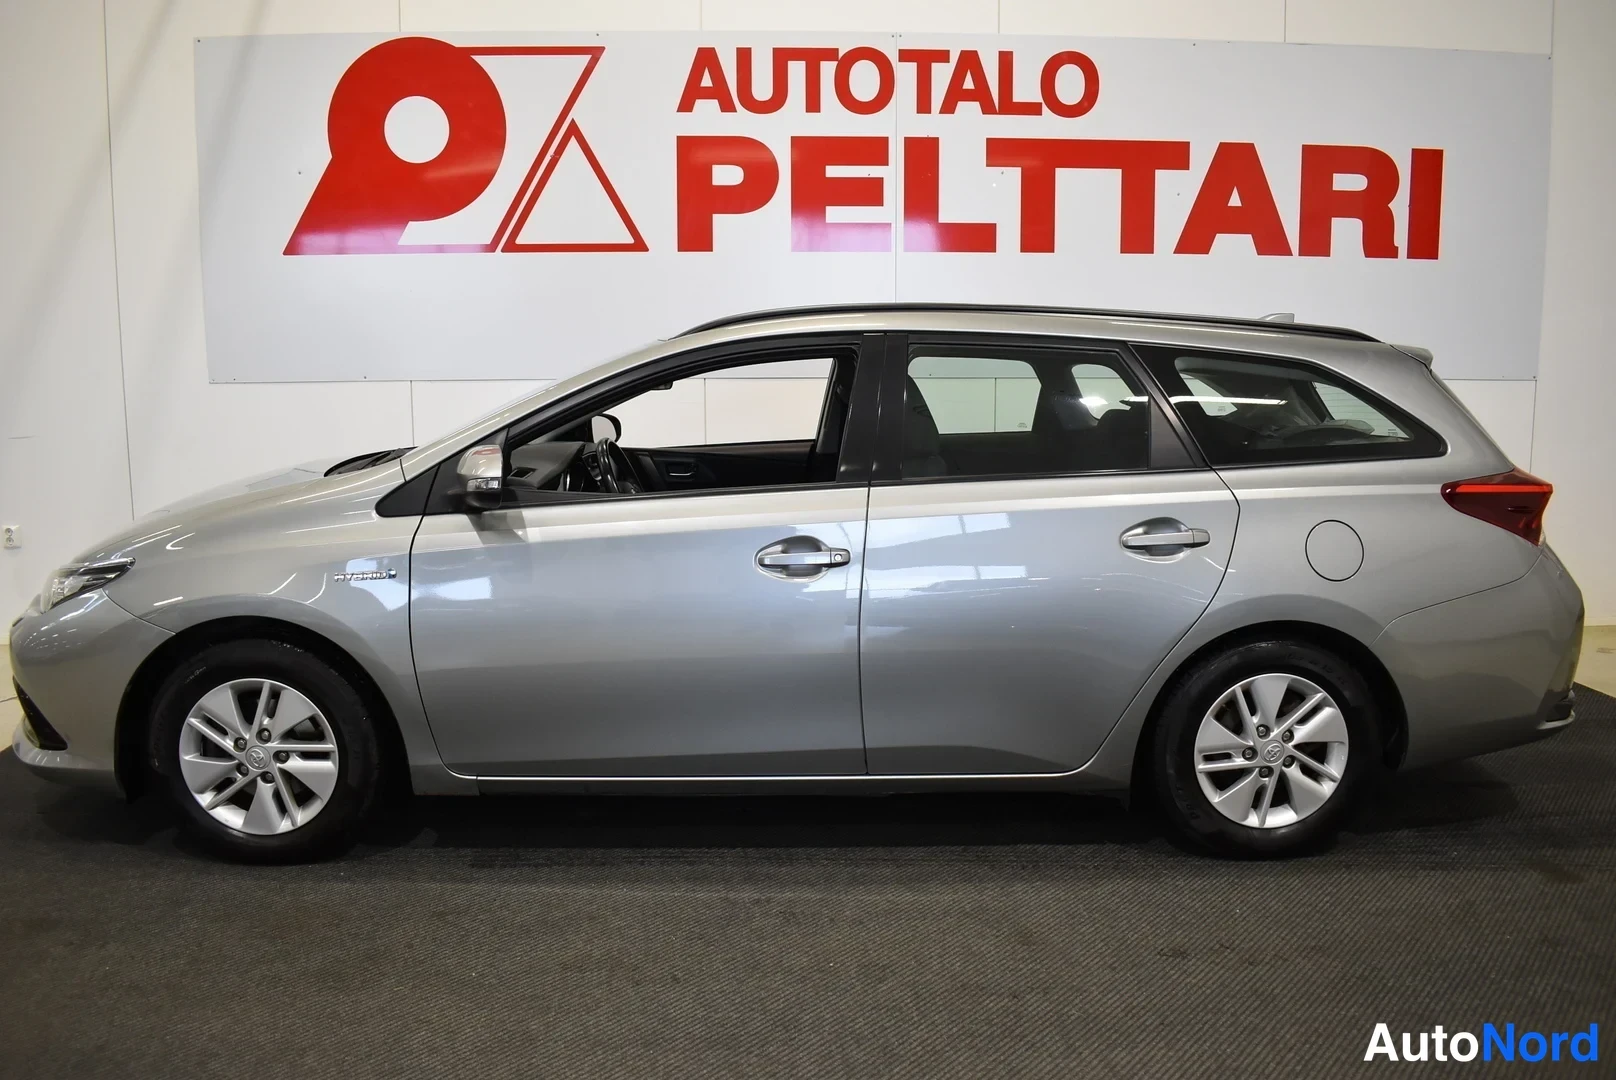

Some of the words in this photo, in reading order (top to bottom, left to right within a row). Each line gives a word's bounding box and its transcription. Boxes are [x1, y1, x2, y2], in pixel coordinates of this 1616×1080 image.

[677, 46, 1101, 118] AUTOTALO
[676, 135, 1444, 260] PELTTARI
[334, 570, 388, 582] HYBRID
